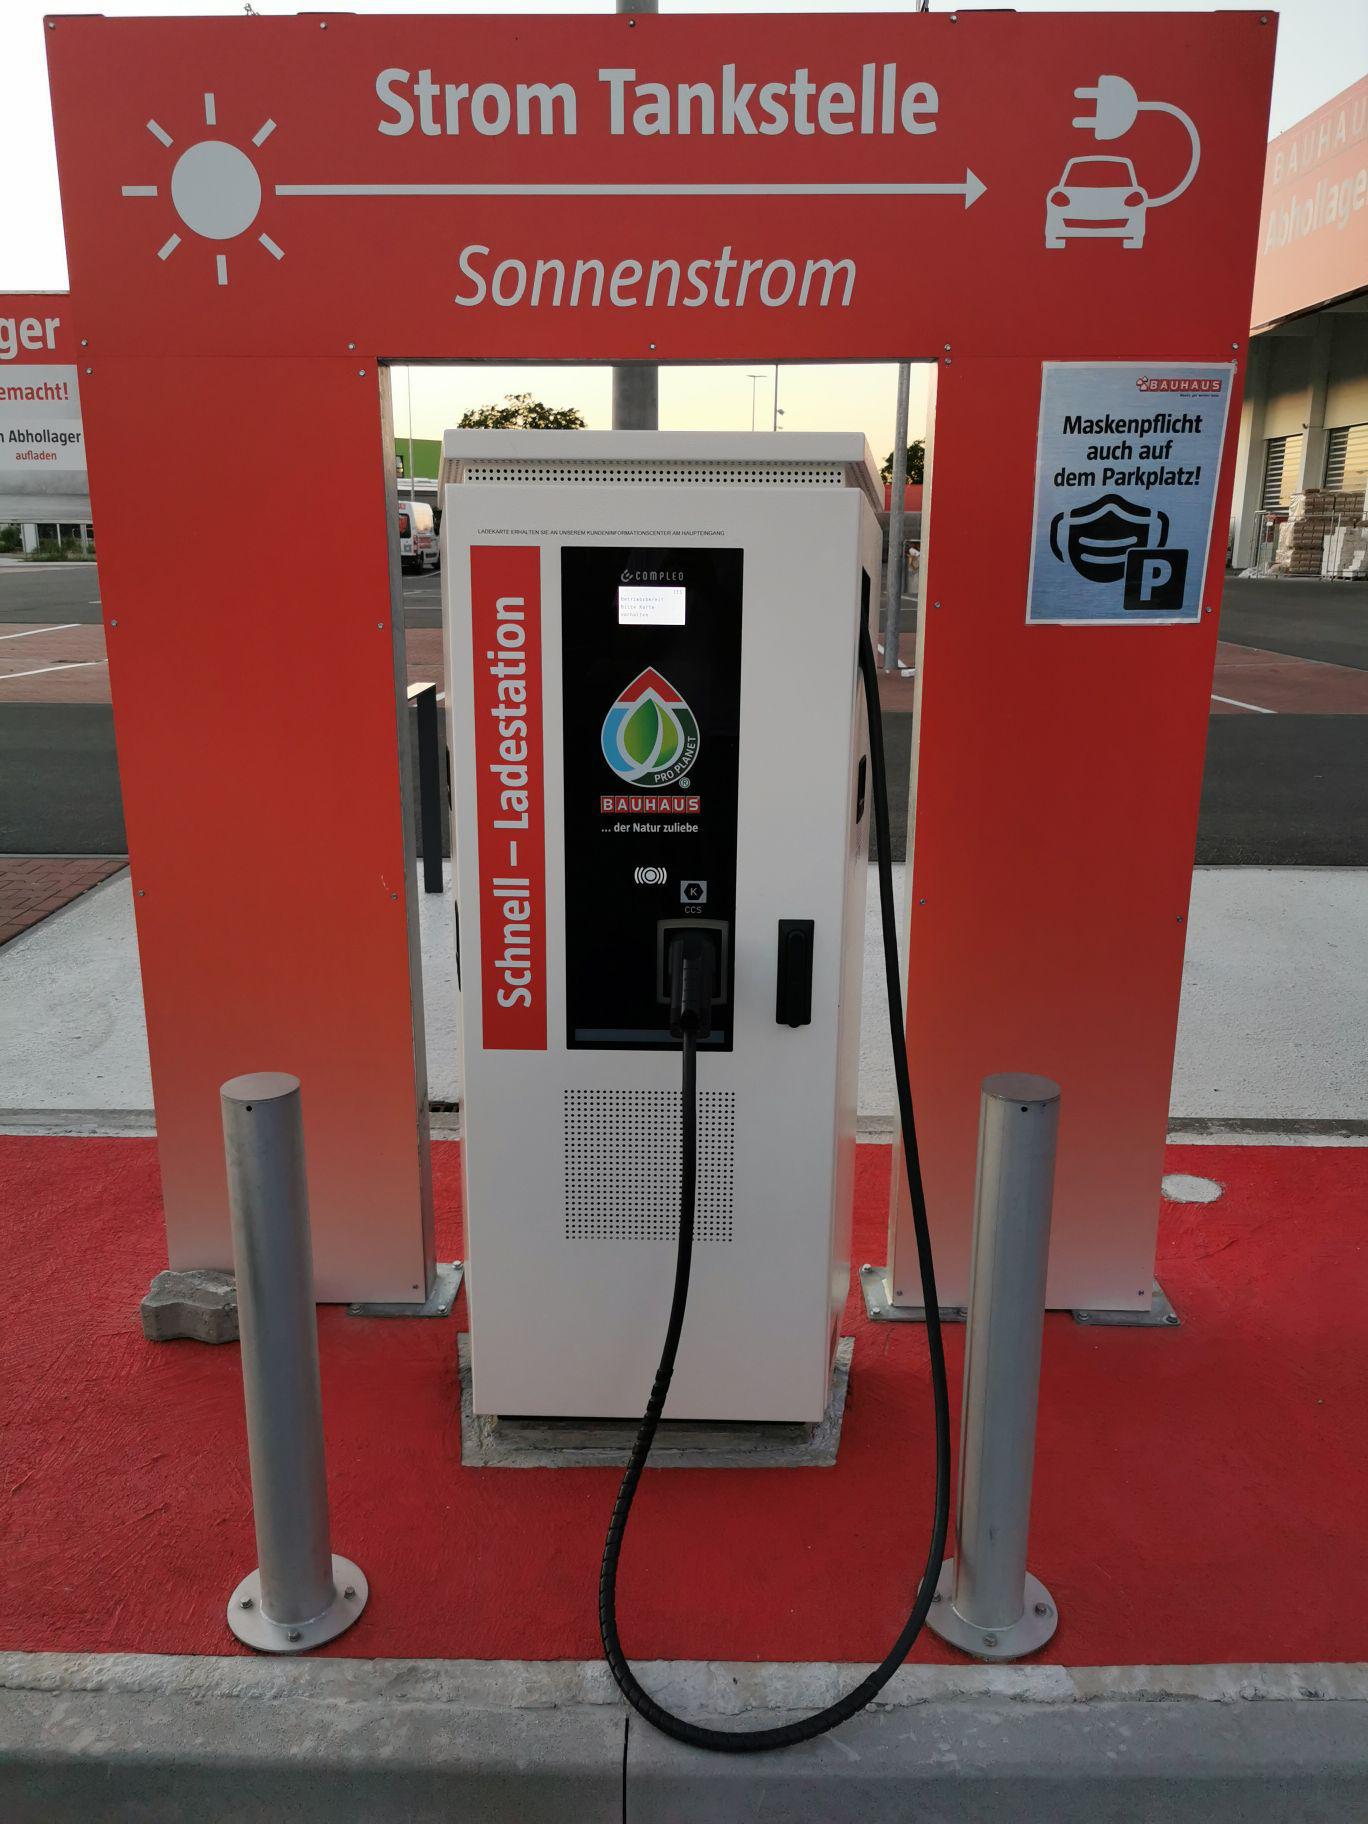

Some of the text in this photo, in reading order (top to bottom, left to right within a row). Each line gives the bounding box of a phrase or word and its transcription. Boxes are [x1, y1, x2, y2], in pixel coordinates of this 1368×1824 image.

[375, 63, 939, 137] Strom Tankstelle
[1263, 167, 1368, 256] Abhollage
[454, 244, 857, 307] Sonnenstrom
[0, 317, 61, 360] ger
[0, 382, 69, 401] emacht!
[1149, 380, 1221, 391] BAUHAUS
[1062, 413, 1203, 438] Maskenpflicht
[8, 429, 82, 446] Abhollager
[15, 450, 57, 461] aufladen
[1086, 439, 1174, 461] auch auf
[1053, 465, 1202, 491] dem Parkplatz!
[635, 571, 684, 581] COMPLEO
[1140, 558, 1172, 601] P
[486, 597, 529, 829] Ladestation
[654, 735, 696, 783] PRO PLANET
[603, 798, 699, 811] BAUHAUS
[613, 822, 631, 833] der
[632, 822, 661, 833] Natur
[663, 822, 699, 833] zuliebe
[690, 887, 698, 896] K
[684, 905, 703, 914] CCS
[492, 877, 532, 1008] Schnell
